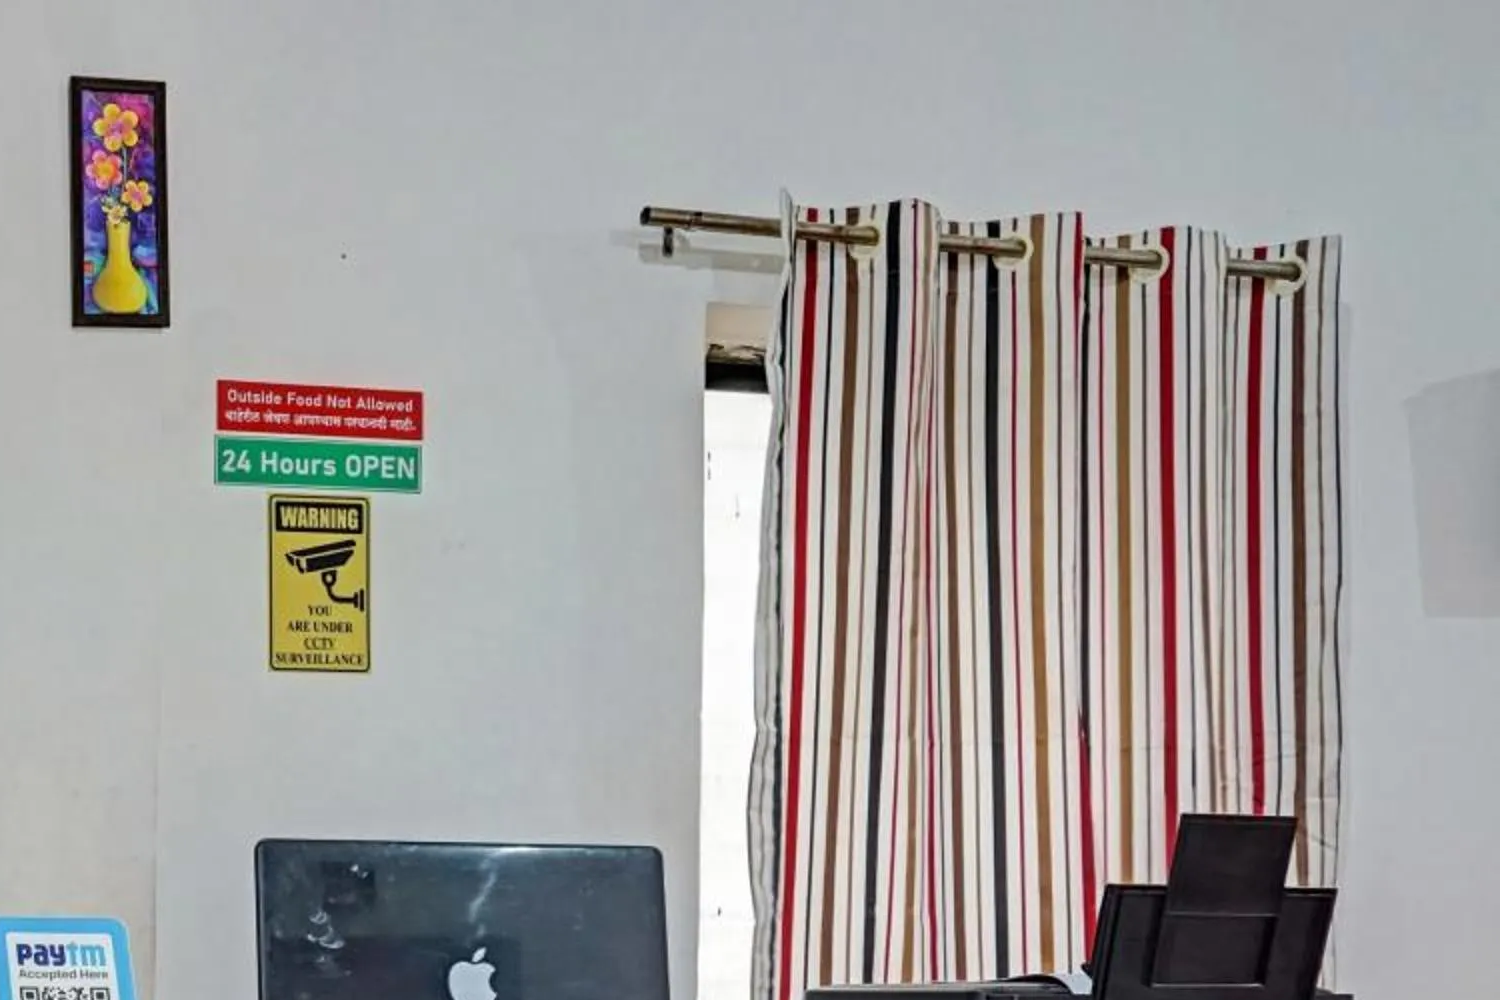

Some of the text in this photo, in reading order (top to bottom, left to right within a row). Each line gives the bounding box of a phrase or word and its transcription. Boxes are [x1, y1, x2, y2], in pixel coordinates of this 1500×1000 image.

[227, 388, 413, 412] Outside Food Not Allowed
[222, 449, 415, 480] 24 Hours OPEN
[279, 505, 359, 531] WARNING
[307, 605, 332, 617] YOU
[287, 620, 353, 633] ARE UNDER
[275, 653, 364, 666] SURVEILLANCE
[18, 969, 109, 981] Accepted Here
